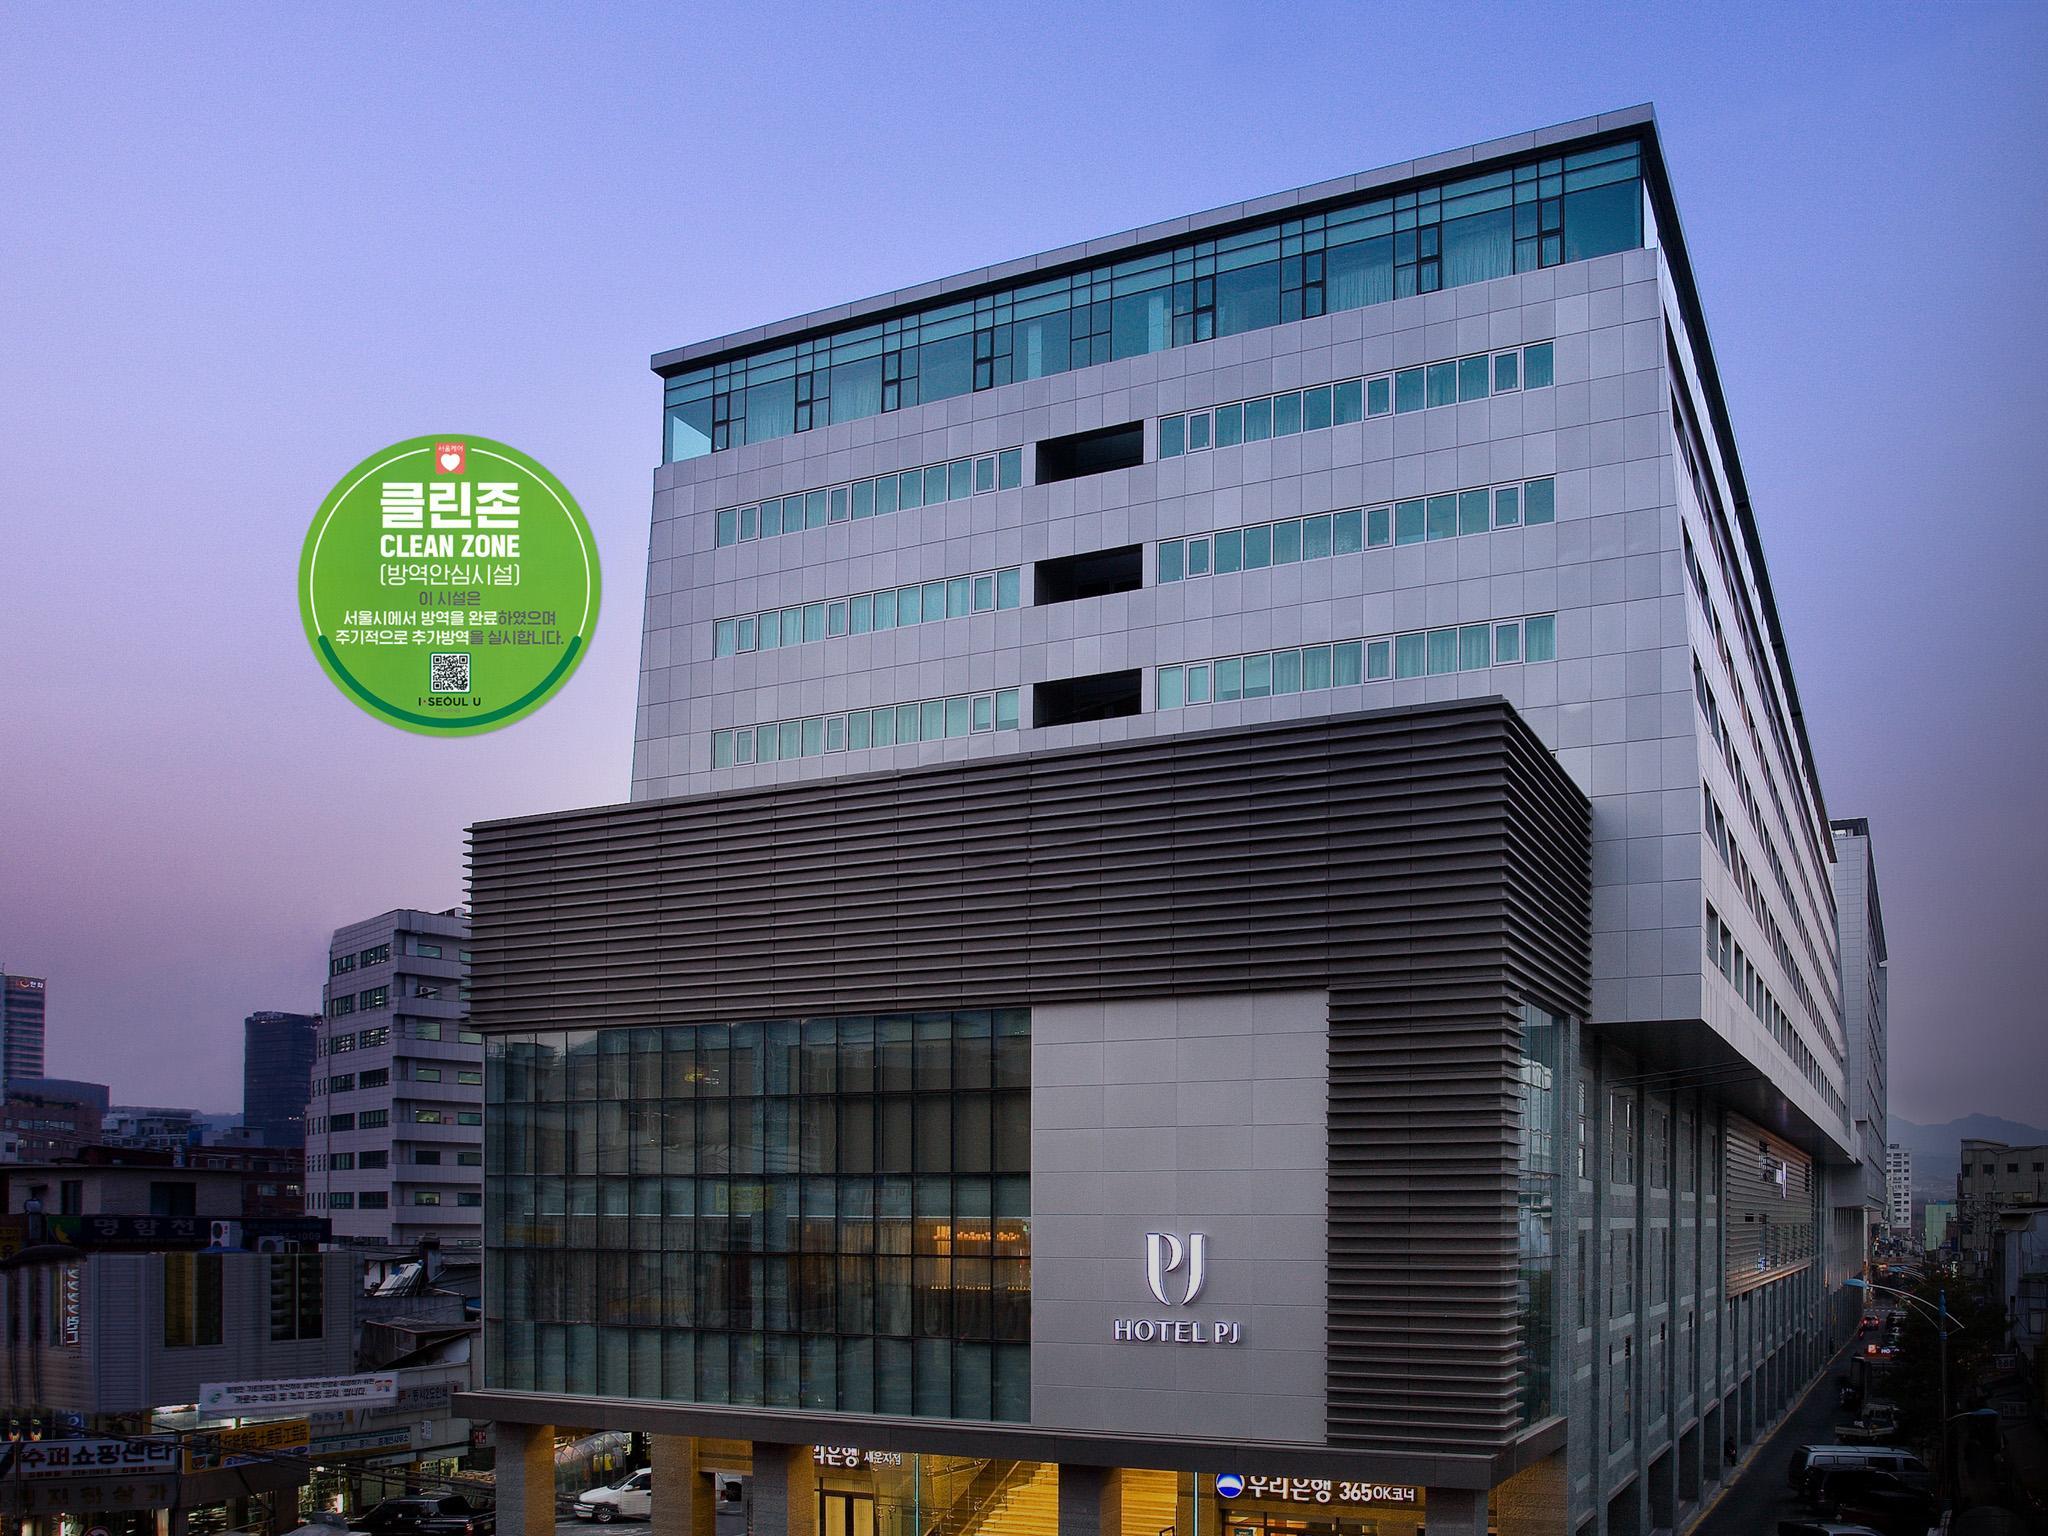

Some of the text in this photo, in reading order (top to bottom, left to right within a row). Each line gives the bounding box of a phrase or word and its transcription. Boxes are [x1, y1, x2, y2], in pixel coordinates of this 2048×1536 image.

[1113, 1319, 1242, 1344] HOTEL PJ
[21, 1443, 173, 1468] 수퍼쇼핑센타
[1247, 1475, 1333, 1503] 우리은행
